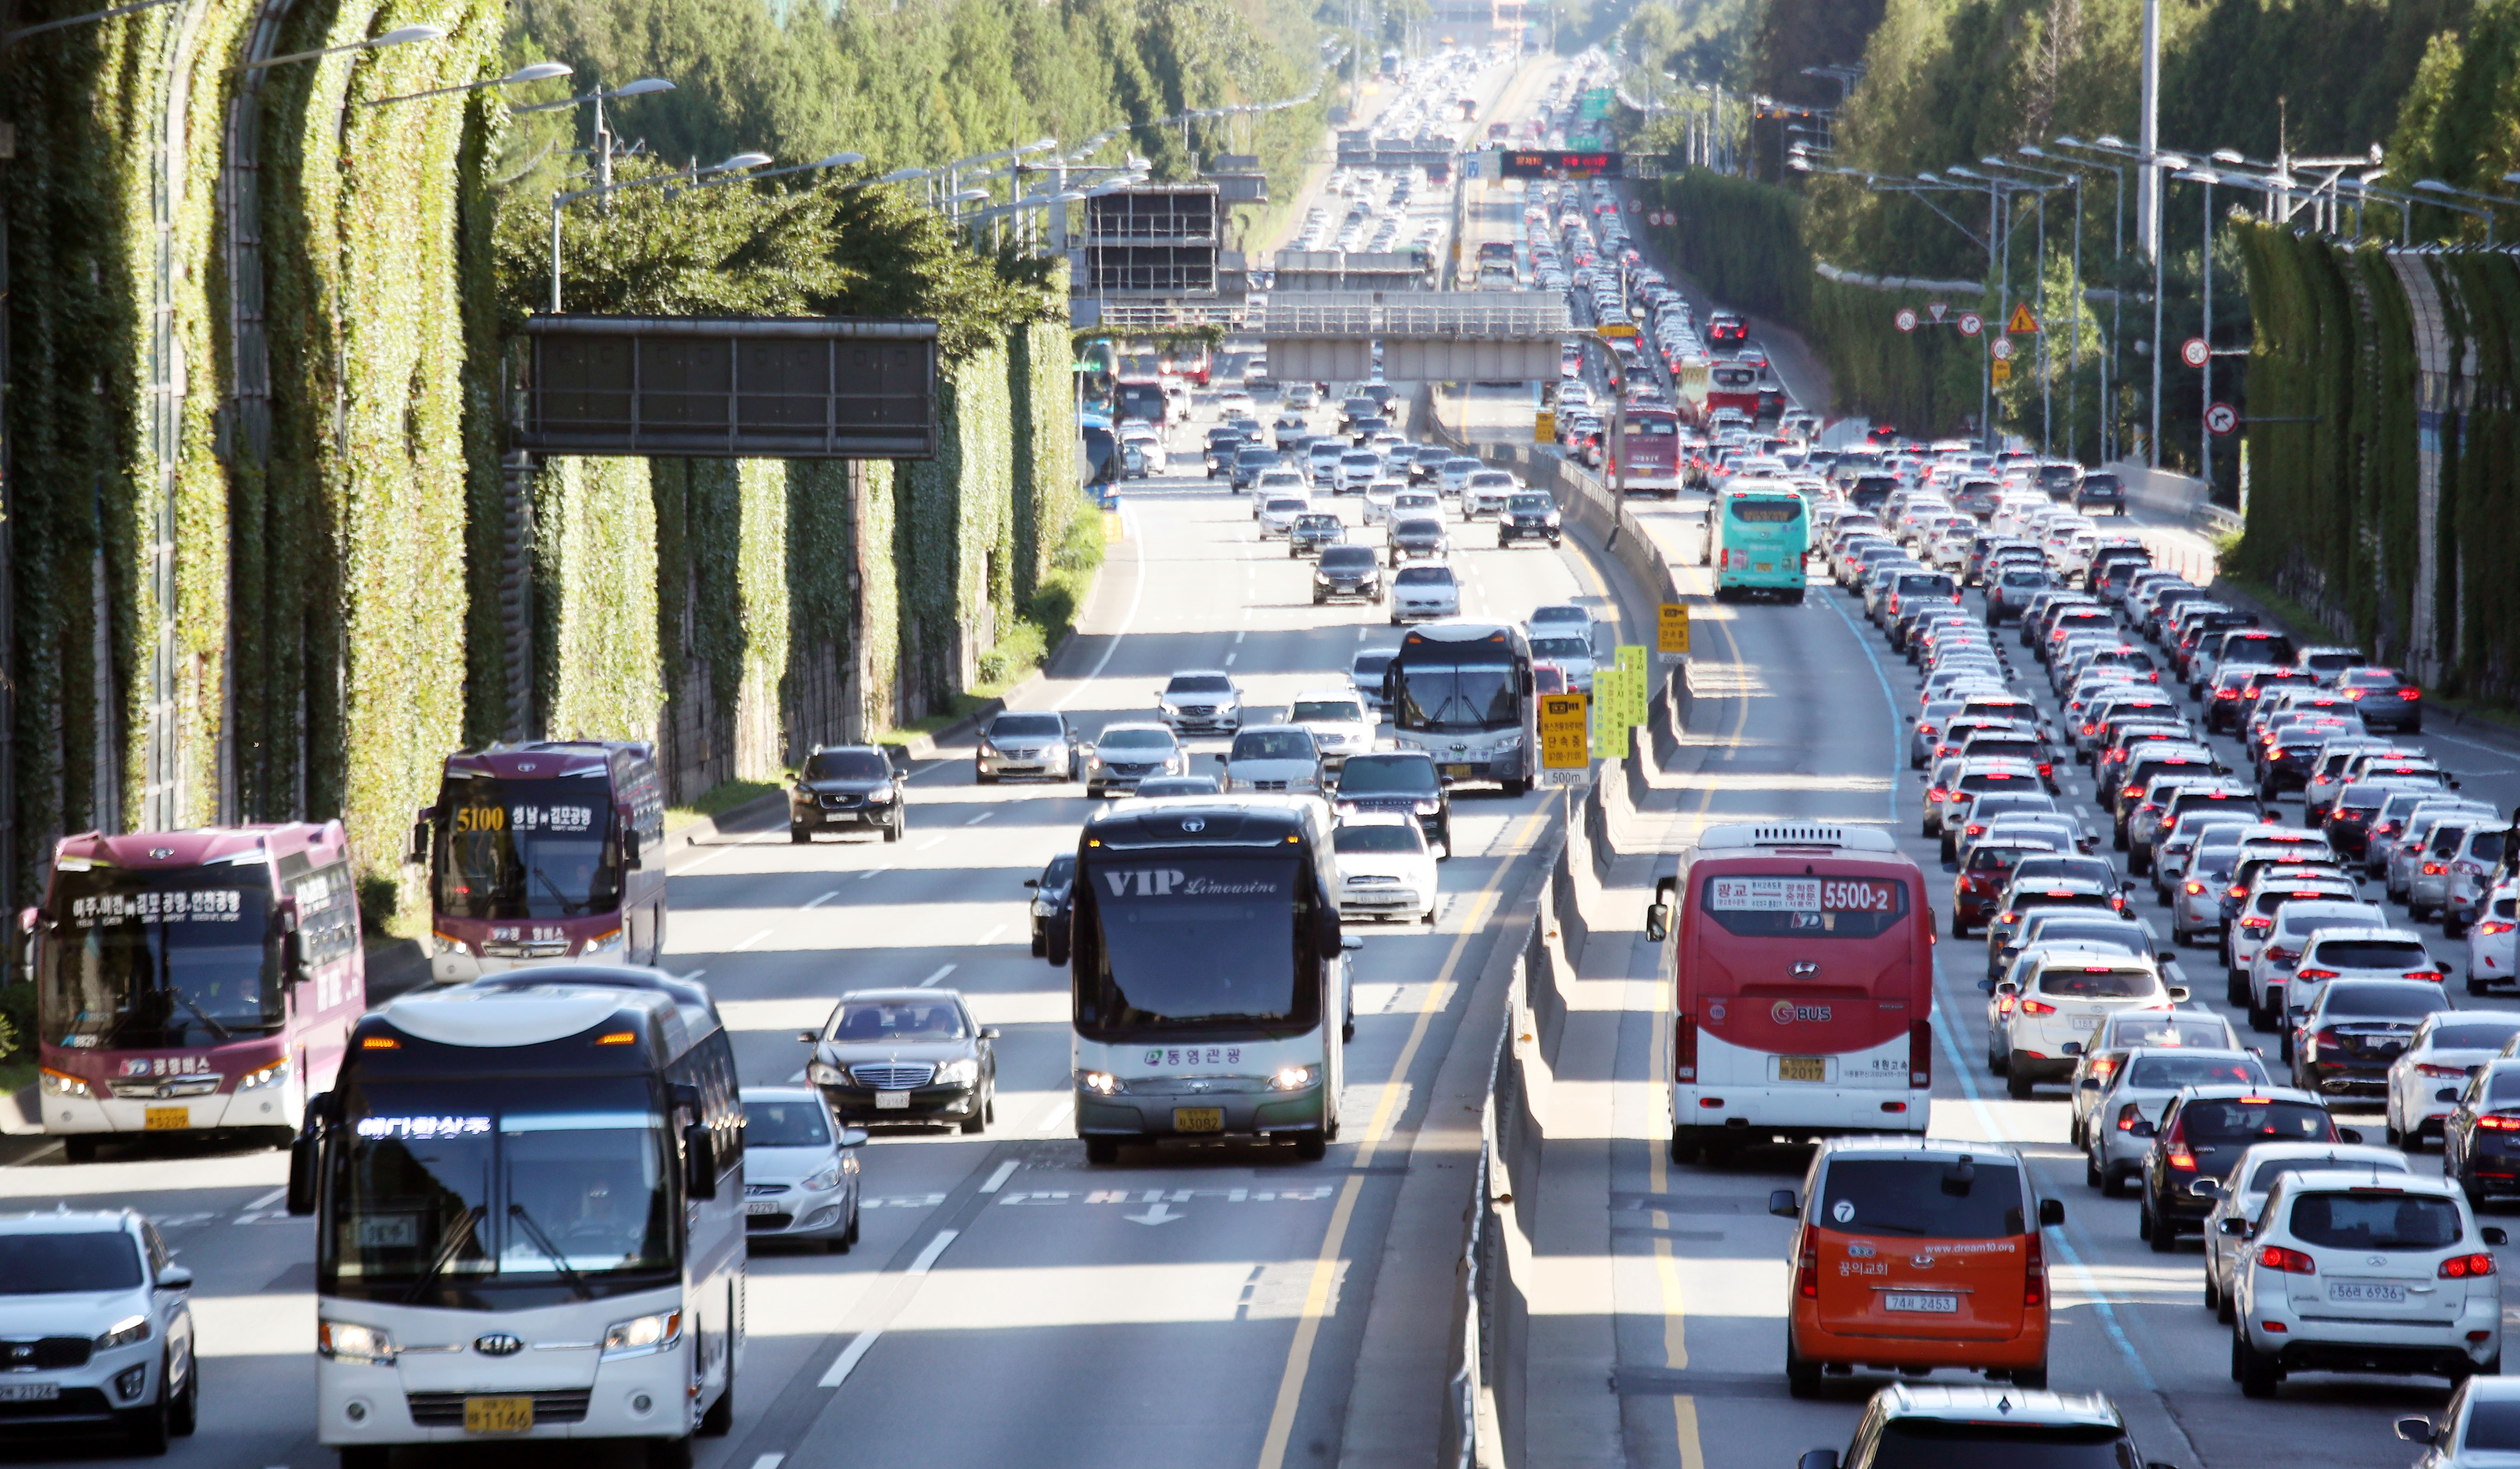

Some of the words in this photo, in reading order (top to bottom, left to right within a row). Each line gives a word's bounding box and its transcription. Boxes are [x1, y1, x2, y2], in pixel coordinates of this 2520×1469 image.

[1552, 773, 1581, 783] 500m
[457, 807, 504, 832] 5100
[512, 806, 538, 824] 성남
[551, 806, 591, 825] 김포공항
[1104, 869, 1184, 897] VIP
[1185, 877, 1277, 895] Limousine
[1718, 885, 1747, 898] 광교
[1824, 883, 1888, 910] 5500-2
[1168, 1049, 1240, 1065] 동영관광
[153, 1057, 210, 1076] 공항버스
[1791, 1068, 1823, 1080] 2017
[1838, 1206, 1851, 1221] 7
[1925, 1243, 2015, 1253] www.dream10.org
[1839, 1262, 1888, 1276] 꿈의교회
[2367, 1286, 2397, 1299] 6936
[1921, 1298, 1950, 1310] 2453
[485, 1410, 529, 1429] 1146
